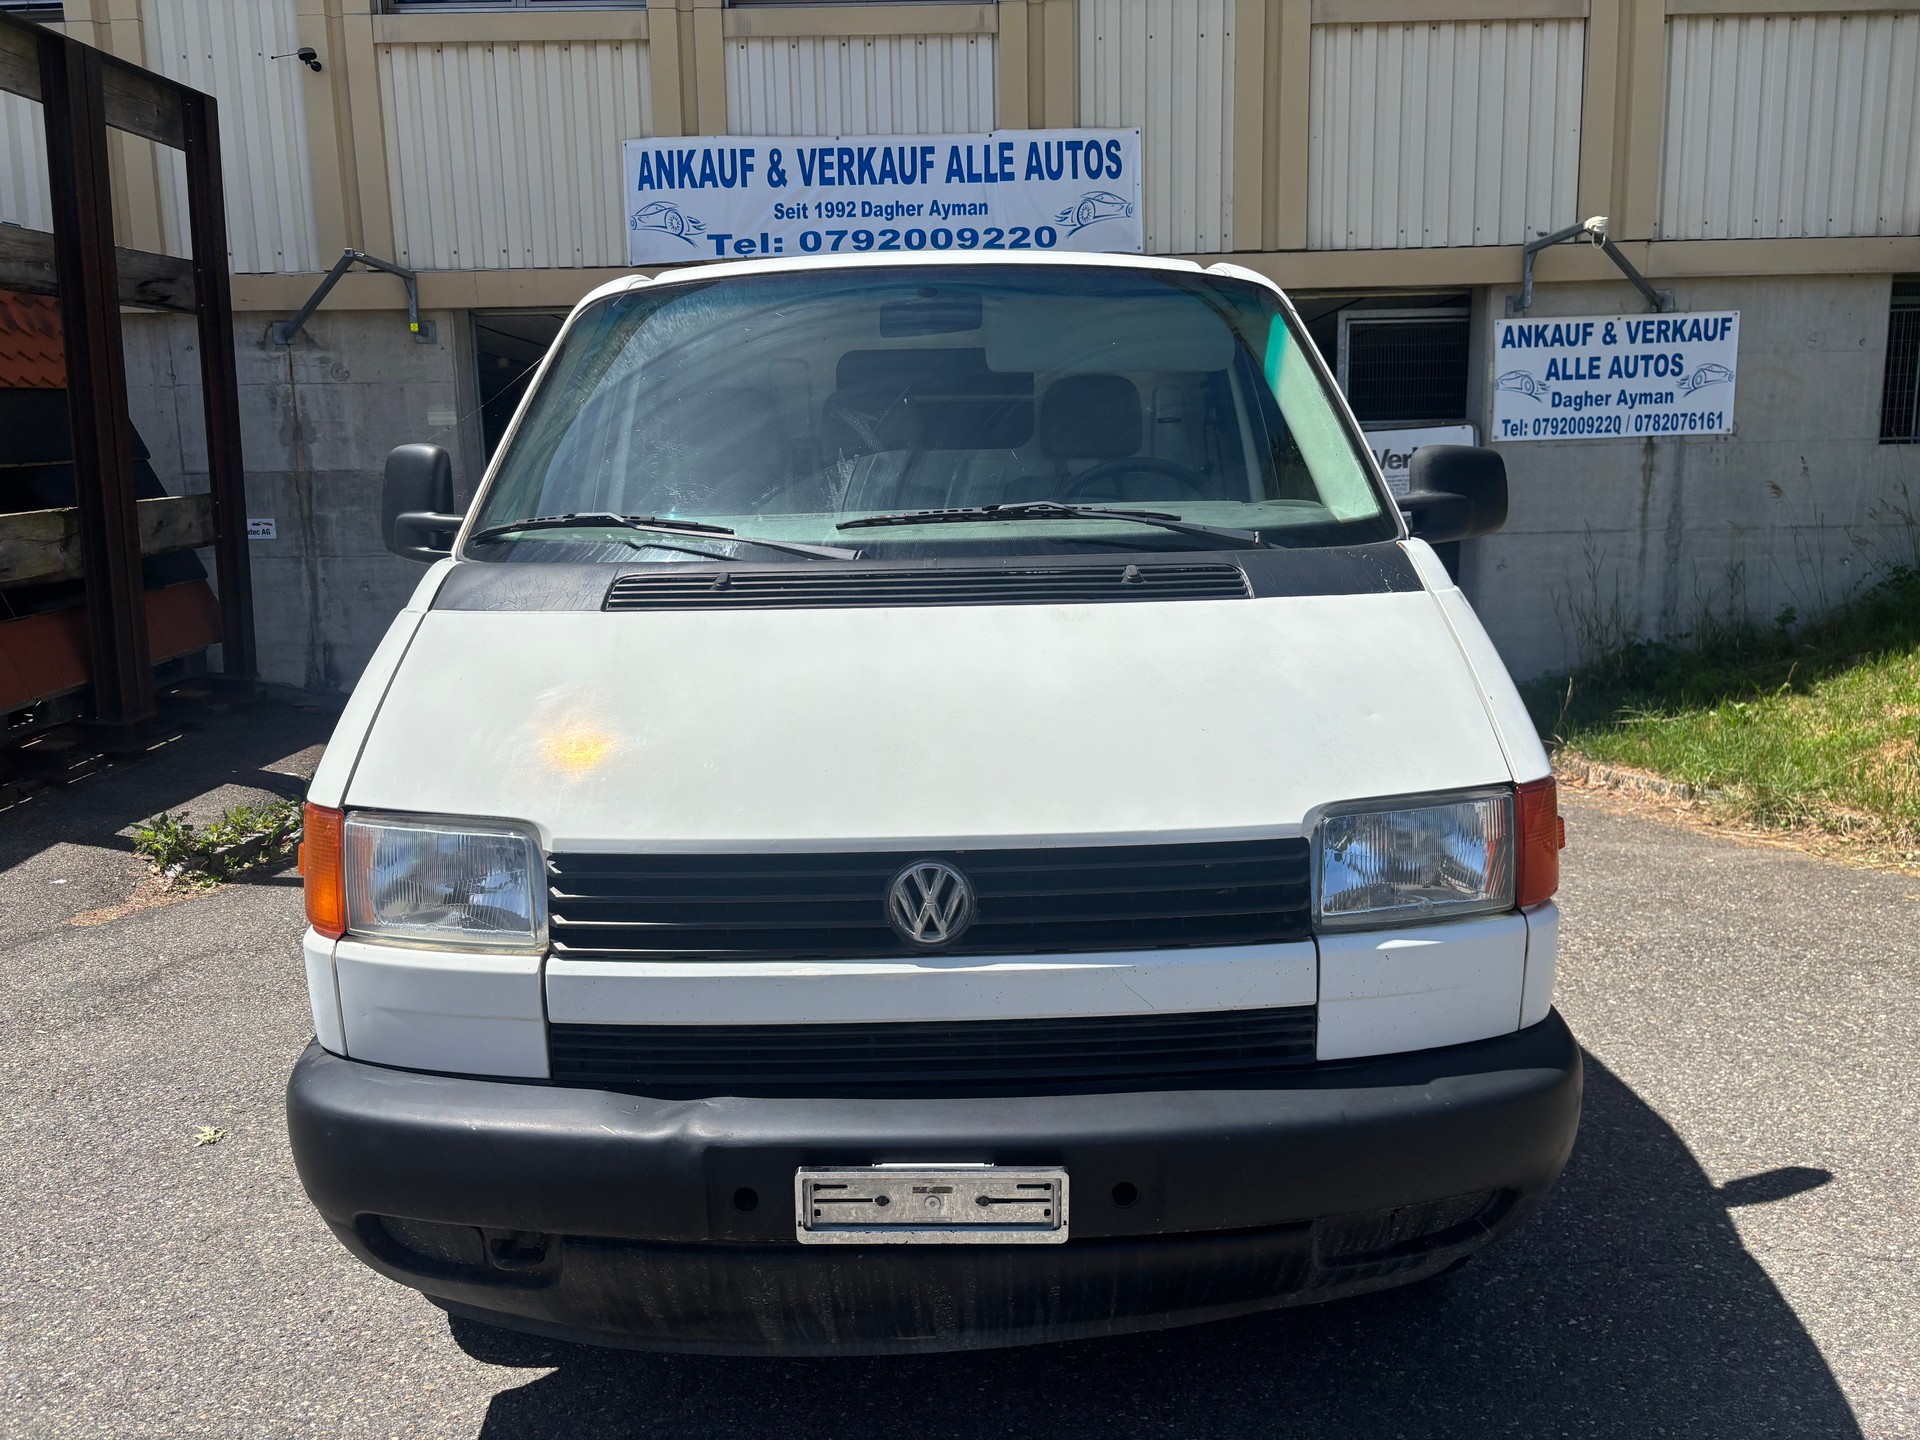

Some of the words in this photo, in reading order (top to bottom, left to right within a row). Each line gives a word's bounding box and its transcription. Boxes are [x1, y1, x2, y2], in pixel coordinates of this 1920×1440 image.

[637, 147, 756, 192] ANKAUF
[766, 147, 789, 189] &
[795, 145, 936, 188] VERKAUF
[944, 141, 1016, 184] ALLE
[1024, 138, 1123, 182] AUTOS
[773, 202, 809, 221] Seit
[814, 201, 857, 219] 1992
[860, 200, 925, 222] Dagher
[928, 199, 989, 221] Ayman
[706, 232, 784, 257] Tel:
[798, 225, 1058, 253] 0792009220
[1500, 322, 1595, 350] ANKAUF
[1601, 321, 1618, 346] &
[1625, 316, 1733, 345] VERKAUF
[1544, 355, 1602, 382] ALLE
[1607, 352, 1685, 380] AUTOS
[1550, 390, 1613, 413] Dagher
[1615, 388, 1675, 410] Ayman
[1502, 419, 1529, 437] Tel:
[1532, 415, 1622, 437] 0792009220
[1634, 411, 1724, 433] 0782076161
[1371, 446, 1418, 471] Ver
